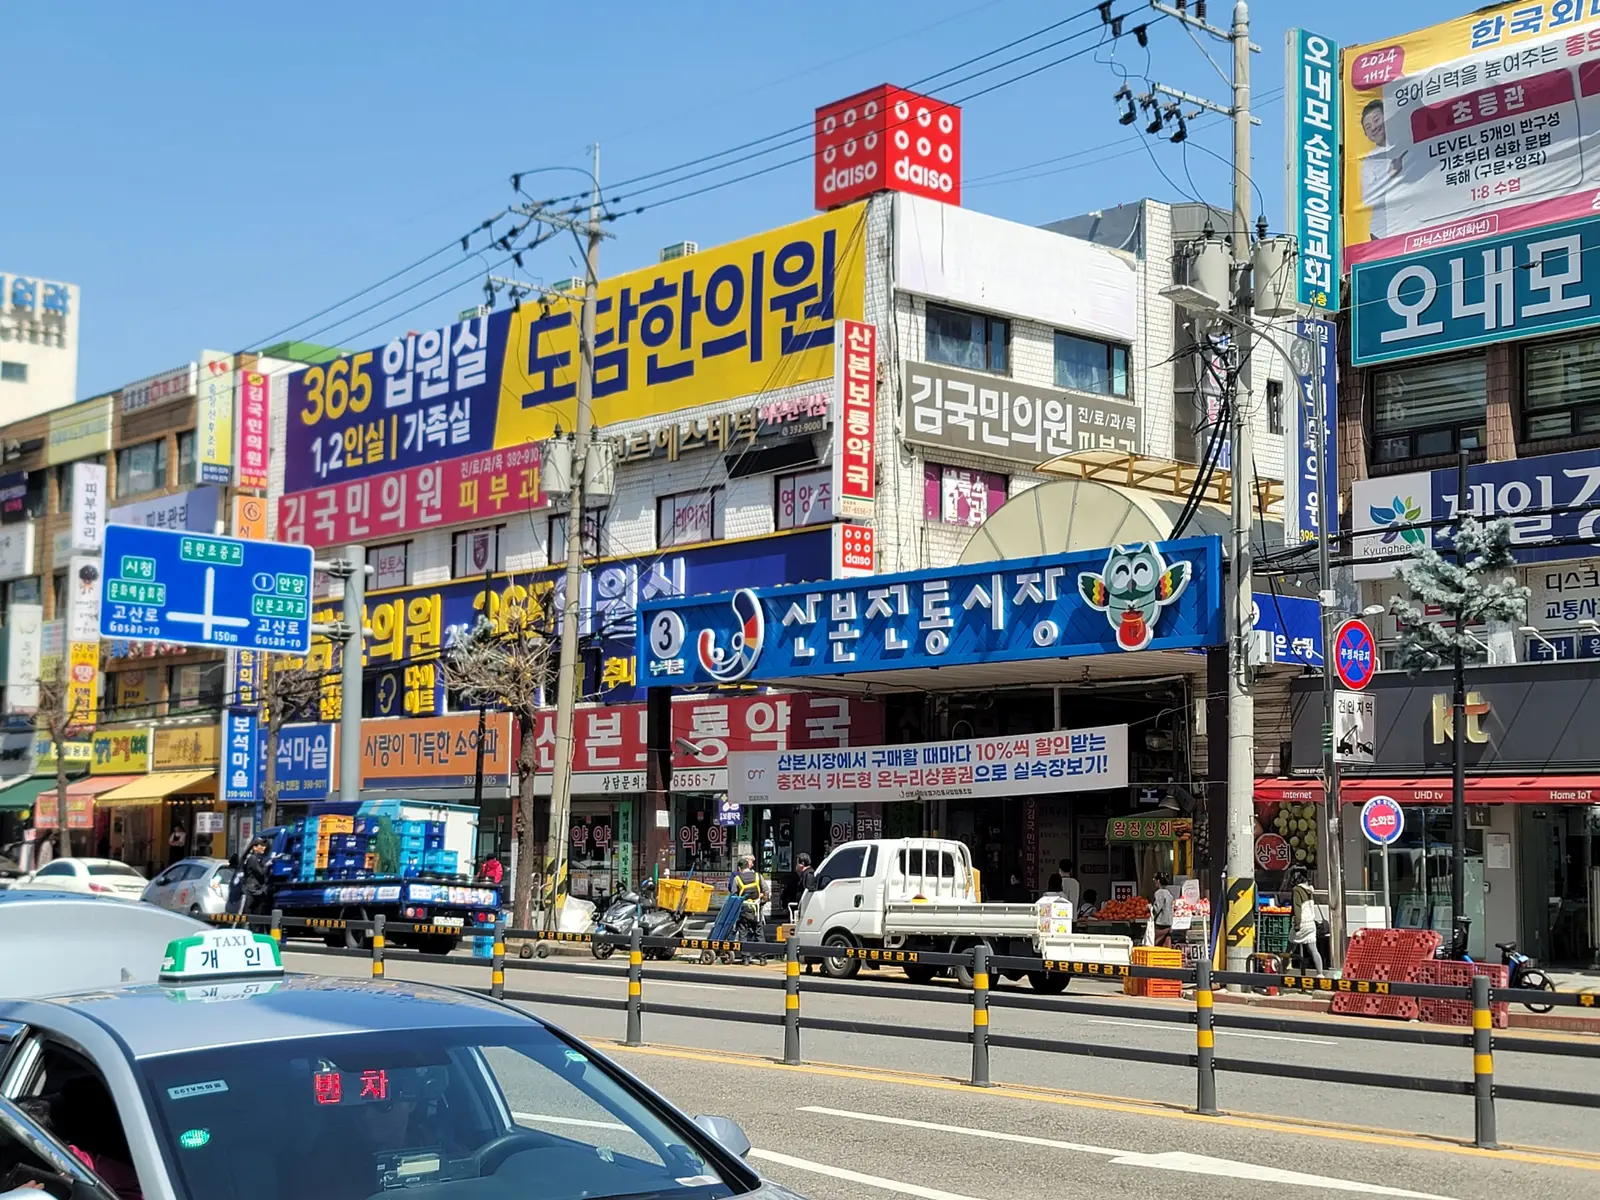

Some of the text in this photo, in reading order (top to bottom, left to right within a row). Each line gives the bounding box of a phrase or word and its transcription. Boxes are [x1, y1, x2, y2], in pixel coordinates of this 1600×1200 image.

[1361, 49, 1397, 68] 2024
[1363, 65, 1392, 83] 개강
[1395, 63, 1478, 107] 영어실력을
[1485, 45, 1559, 80] 높여주는
[1452, 84, 1525, 124] 초등관
[1429, 111, 1561, 158] LEVEL 5개의 반구성
[1440, 131, 1552, 171] 기초부터 심화 문법
[895, 156, 953, 193] daiso
[1304, 35, 1332, 294] 오내모 순복음교회
[1446, 150, 1548, 187] 독해 (구문+영작)
[823, 160, 877, 194] daiso
[1470, 177, 1521, 201] 1:8 수업
[1381, 232, 1591, 343] 오내모
[521, 229, 837, 409] 도담한의원
[301, 351, 374, 425] 365
[382, 312, 489, 408] 입원실
[847, 325, 873, 493] 산본보룡약국
[911, 374, 1072, 456] 김국민의원
[1078, 406, 1136, 433] 진/료/과/목
[312, 398, 471, 478] 1,2인실 가족실
[789, 420, 823, 436] 392-9000
[459, 467, 541, 514] 피부과
[283, 466, 442, 545] 김국민의원
[676, 503, 711, 531] 레이저
[183, 541, 242, 559] 곡란초중교
[844, 552, 871, 567] daiso
[1363, 544, 1412, 557] Kyunghee
[125, 561, 153, 573] 시청
[379, 555, 405, 578] 보톡스
[110, 583, 165, 601] 문화예술회관
[259, 576, 268, 589] 1
[279, 578, 305, 593] 안양
[1545, 570, 1599, 593] 디스크
[112, 605, 159, 623] 고산로
[781, 568, 1066, 663] 산본전통시장
[1545, 597, 1600, 620] 교통사
[109, 621, 160, 636] Gosan-ro
[213, 631, 238, 643] 150m
[257, 619, 300, 636] 고산로
[658, 616, 673, 652] 3
[254, 634, 301, 648] Gosan-ro
[1341, 648, 1370, 661] 주정차금지
[404, 664, 435, 688] 다이
[404, 688, 435, 713] 어트
[1338, 699, 1373, 716] 견인지역
[1431, 690, 1491, 745] kt
[536, 698, 852, 770] 산본룡약국
[232, 716, 250, 788] 보석마을
[365, 732, 404, 768] 사랑이
[409, 730, 450, 765] 가득한
[777, 733, 1106, 771] 산본시장에서 구매할 때마다 10%씩 할인받는
[777, 755, 1108, 791] 충전식 카드형 온누리상품권으로 실속장보기!
[1282, 790, 1312, 799] Internet
[1414, 790, 1444, 800] UHD tv
[1550, 791, 1576, 800] Home
[856, 819, 882, 832] 김국민
[1114, 820, 1171, 837] 왕창상회
[1370, 815, 1395, 827] 소화전
[1475, 811, 1485, 823] kt
[571, 825, 612, 854] 약 약
[679, 825, 699, 856] 약
[707, 826, 728, 857] 약
[1256, 844, 1291, 863] 상회
[213, 935, 247, 948] TAXI
